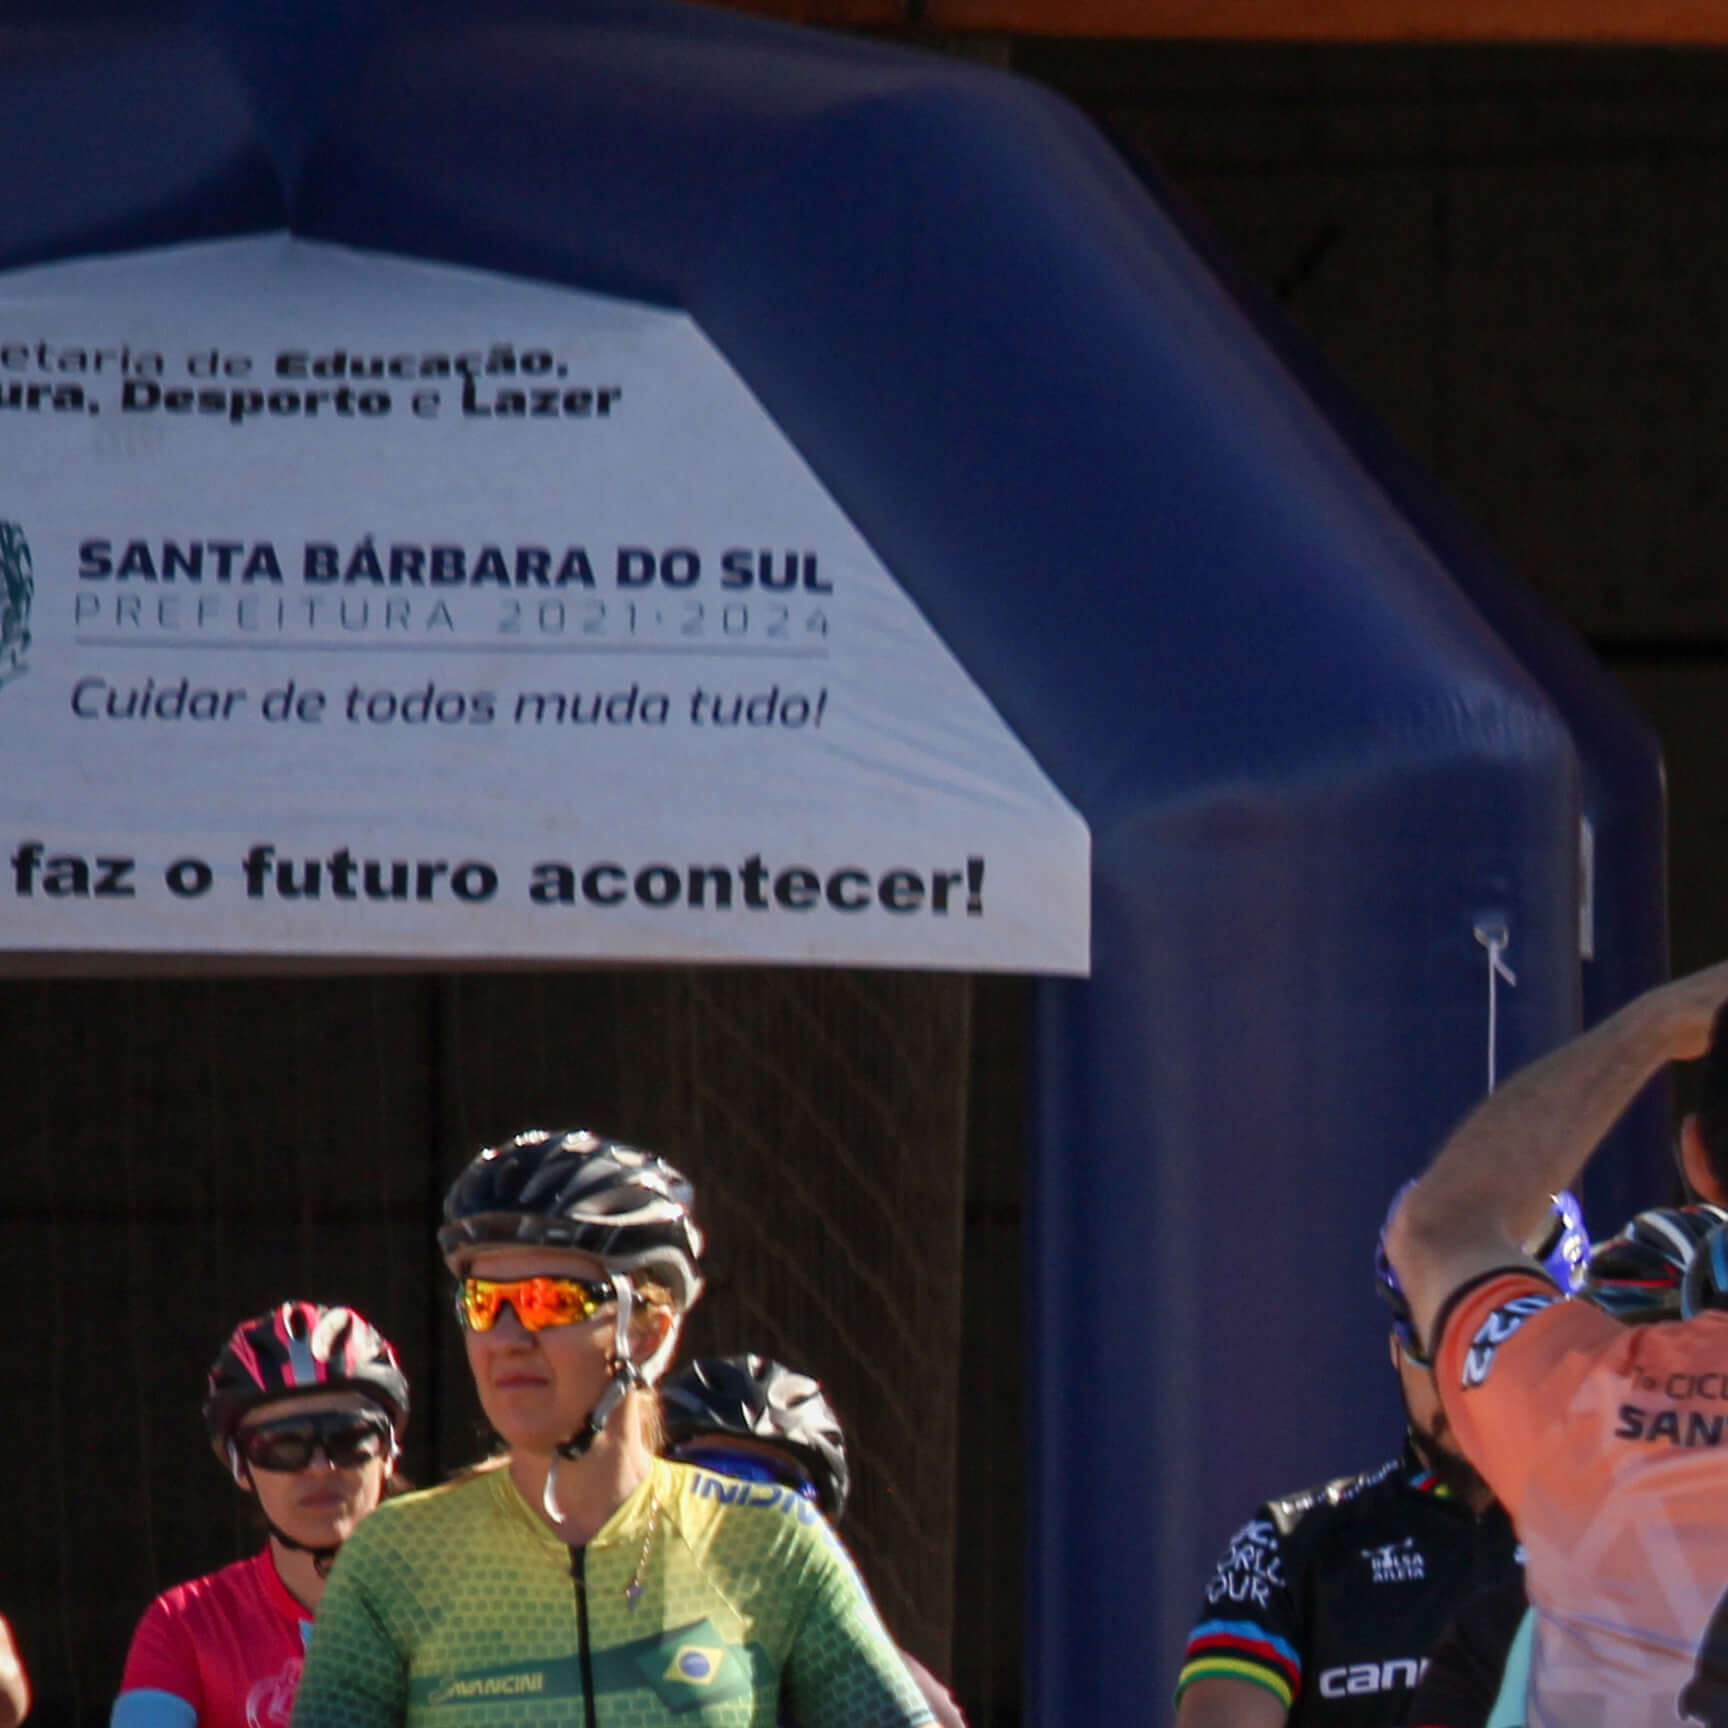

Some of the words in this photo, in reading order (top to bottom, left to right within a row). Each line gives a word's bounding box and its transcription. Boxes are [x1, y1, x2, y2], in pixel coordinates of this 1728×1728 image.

[187, 346, 254, 379] de
[275, 343, 569, 384] Educação,
[120, 380, 393, 425] Desporto
[412, 388, 440, 418] e
[461, 380, 623, 418] Lazer
[78, 540, 283, 585] SANTA
[304, 532, 598, 589] BÁRBARA
[616, 546, 702, 590] DO
[720, 548, 834, 594] SUL
[74, 591, 457, 631] PREFEITURA
[71, 677, 246, 721] Cuidar
[261, 680, 327, 724] de
[346, 681, 496, 725] todos
[513, 683, 670, 727] muda
[689, 685, 829, 729] tudo!
[9, 842, 138, 899] faz
[164, 857, 213, 899] o
[241, 843, 499, 903] futuro
[528, 853, 985, 916] acontecer!
